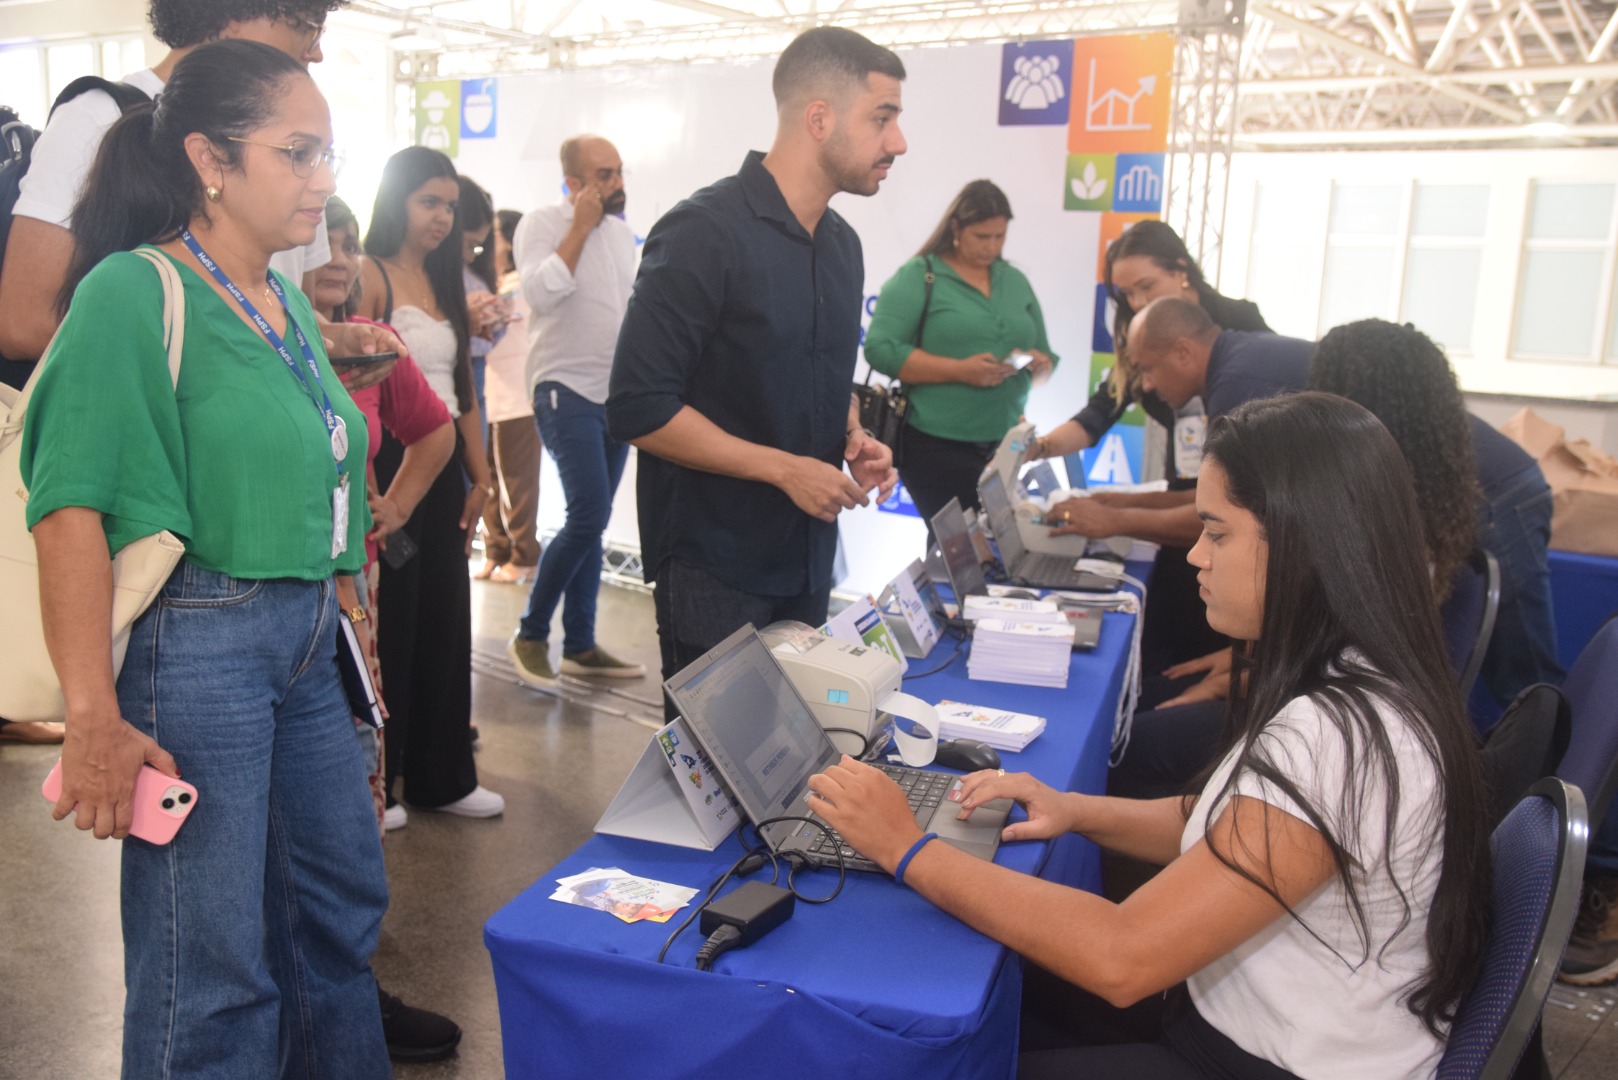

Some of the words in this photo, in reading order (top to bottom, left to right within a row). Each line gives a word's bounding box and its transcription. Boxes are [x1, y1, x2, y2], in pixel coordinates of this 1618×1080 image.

[197, 251, 217, 272] FSPH
[226, 282, 245, 302] FSPH
[268, 278, 283, 296] FSPH
[253, 314, 271, 335] FSPH
[278, 346, 295, 366] FSPH
[307, 359, 320, 378] FSPH
[325, 408, 337, 430] FSPH
